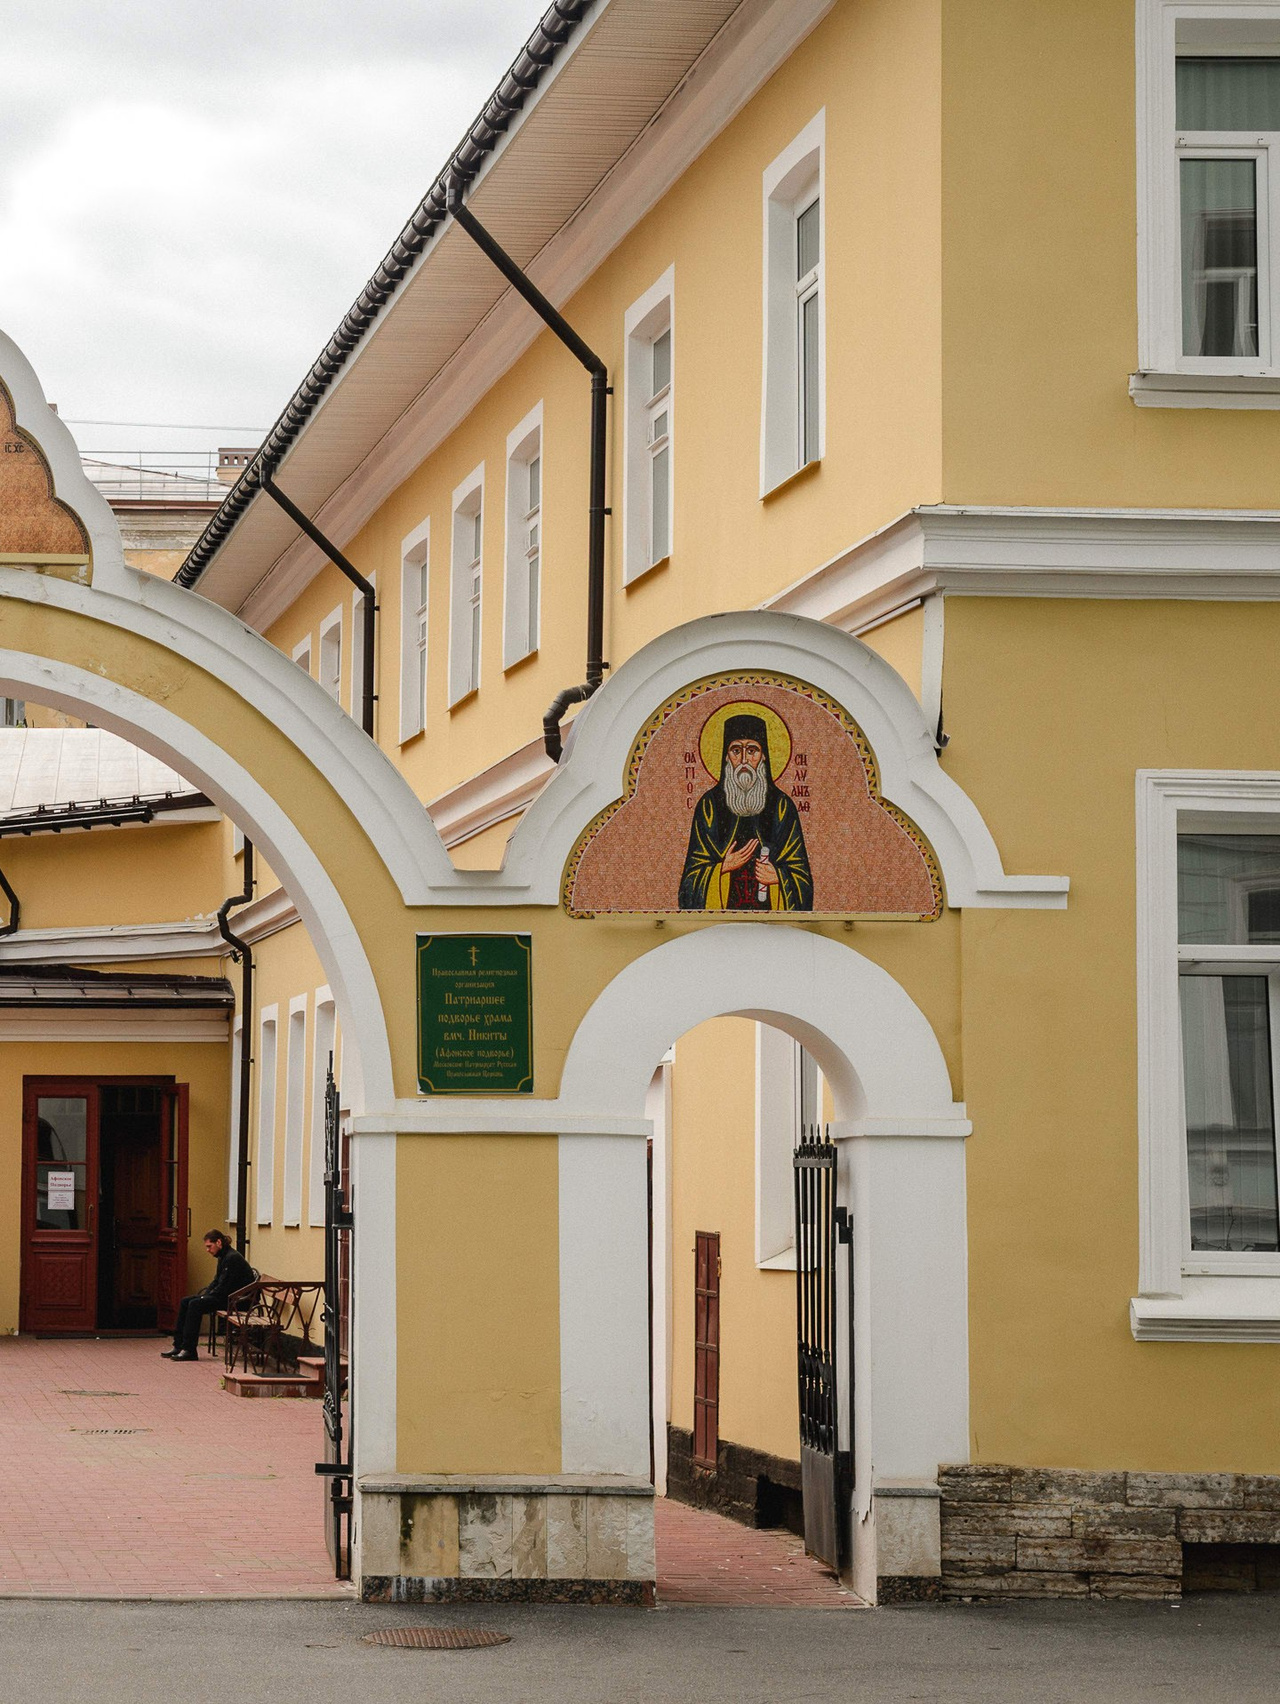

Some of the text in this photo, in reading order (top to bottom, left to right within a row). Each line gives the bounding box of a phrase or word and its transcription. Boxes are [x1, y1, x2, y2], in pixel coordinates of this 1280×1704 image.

[445, 992, 506, 1008] Патриаршее
[438, 1013, 513, 1026] подворье храма
[443, 1028, 508, 1041] вмч. Никиты
